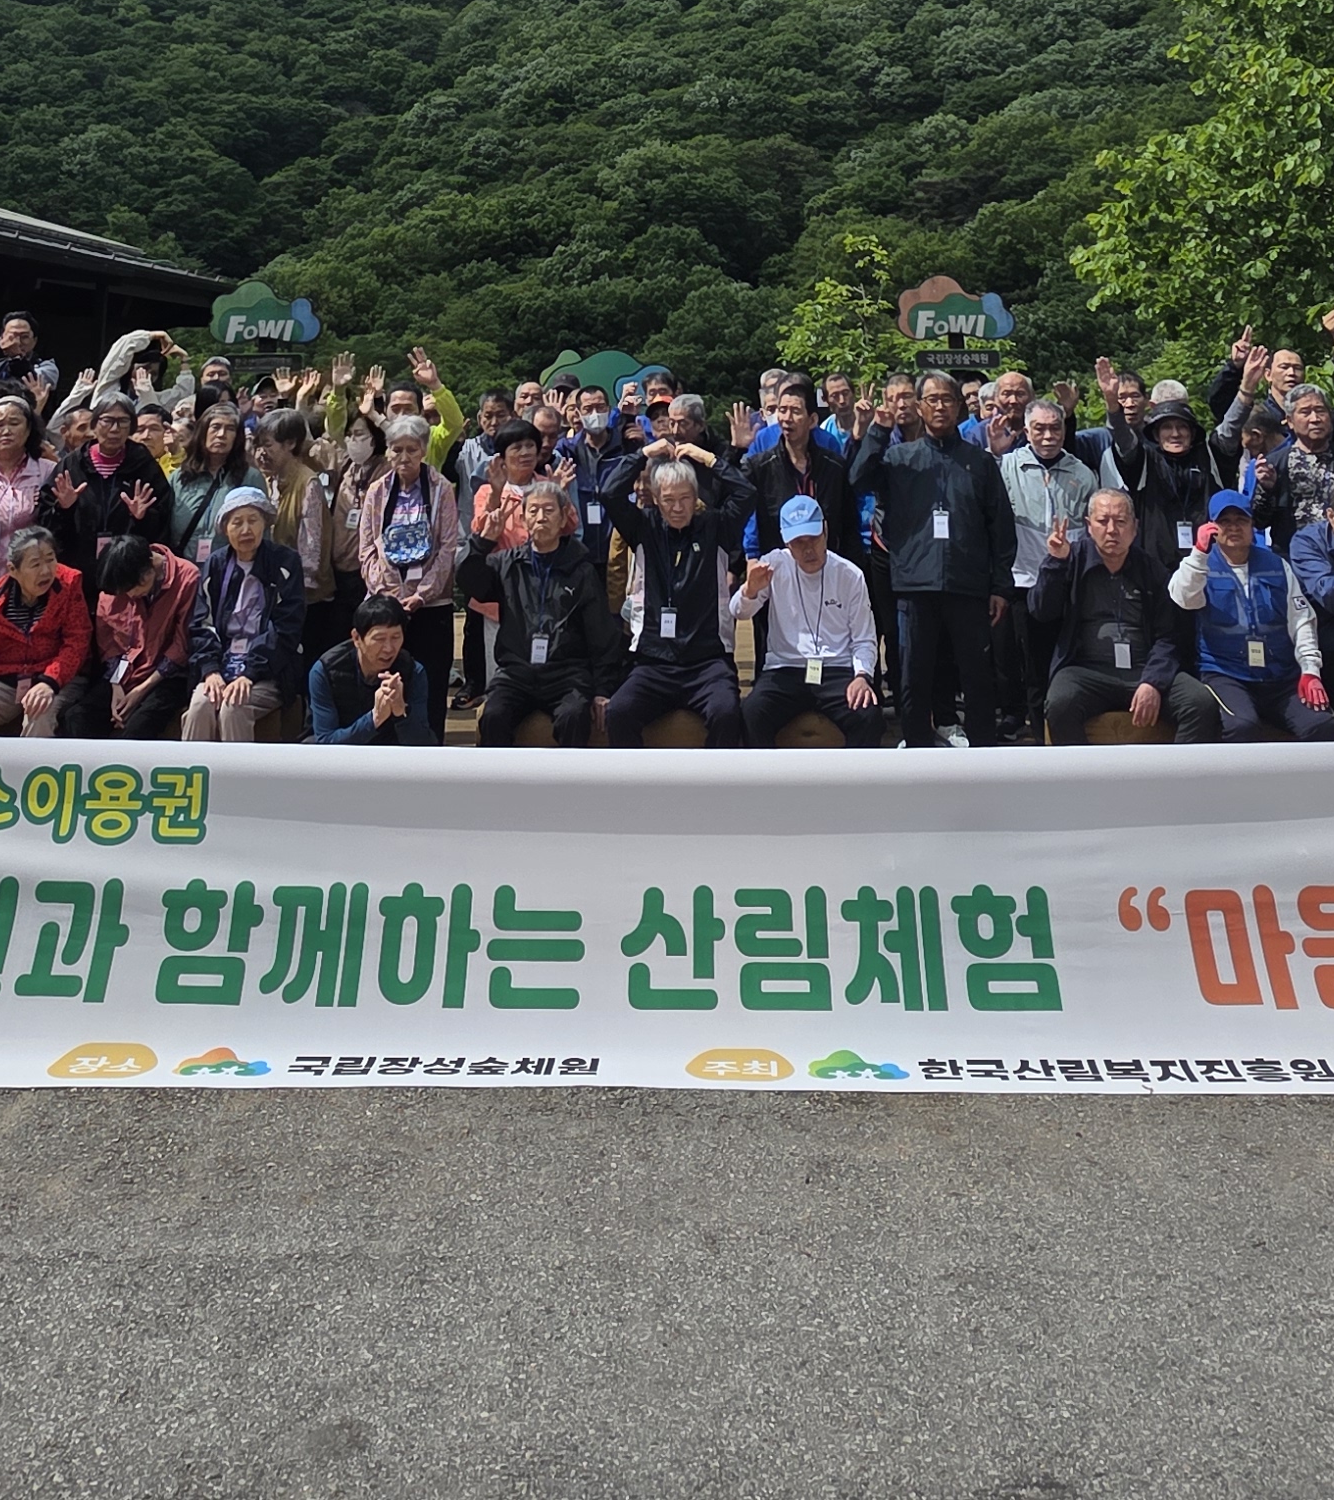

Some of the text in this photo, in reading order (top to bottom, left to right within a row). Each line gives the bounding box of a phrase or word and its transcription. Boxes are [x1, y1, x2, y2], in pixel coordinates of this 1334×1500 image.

[925, 353, 989, 366] 국립장성숲체원
[155, 878, 586, 1010] 함께하는
[620, 883, 1064, 1012] 산림체험
[68, 1055, 601, 1077] 장소 국립장성숲체원
[702, 1057, 779, 1078] 주최
